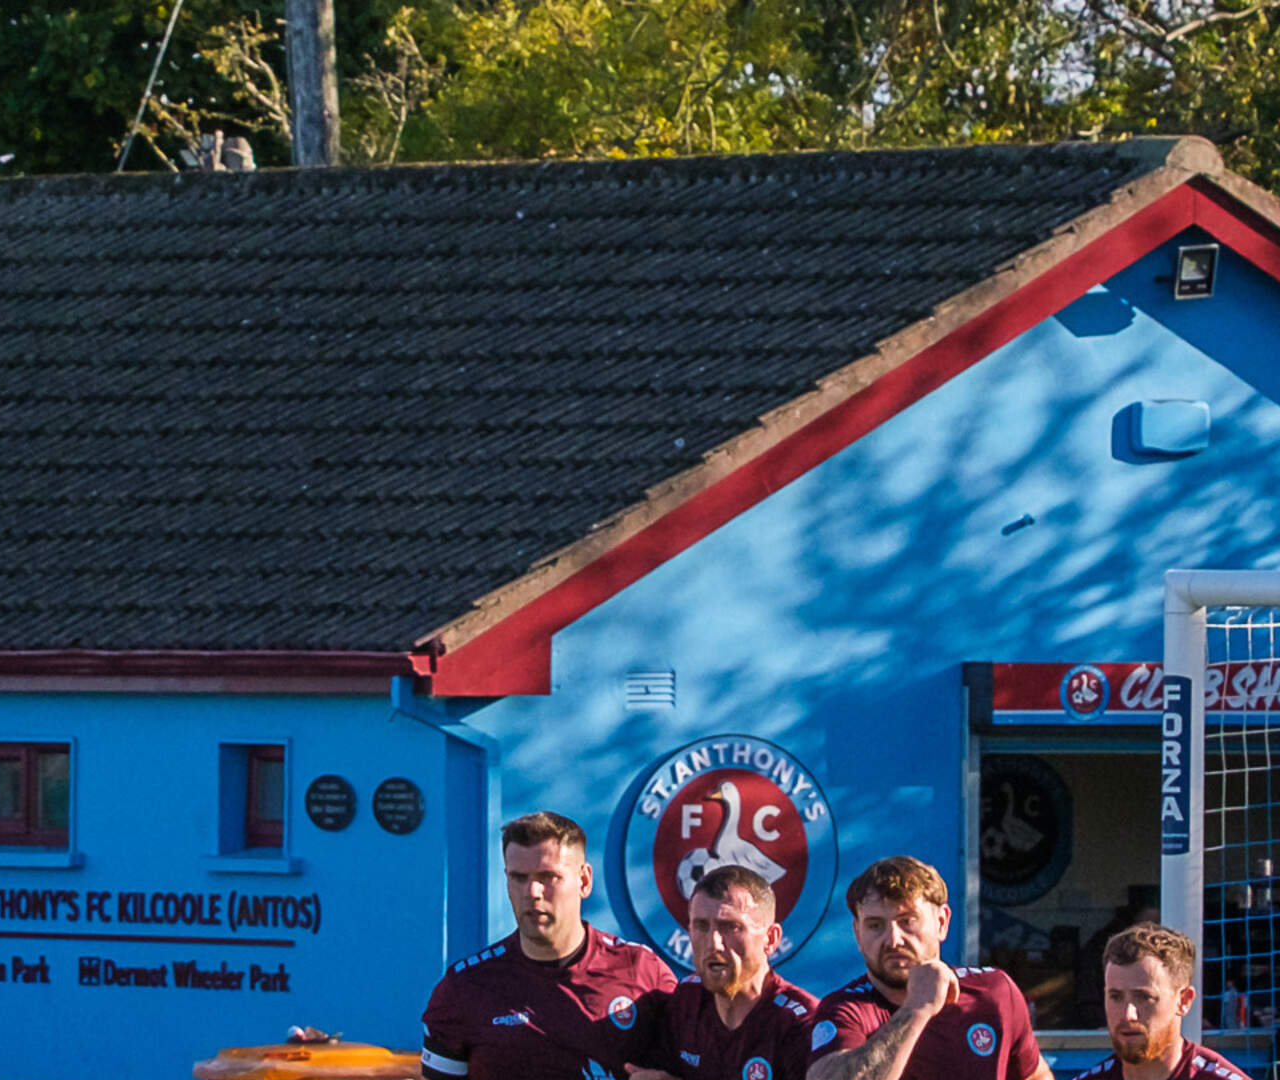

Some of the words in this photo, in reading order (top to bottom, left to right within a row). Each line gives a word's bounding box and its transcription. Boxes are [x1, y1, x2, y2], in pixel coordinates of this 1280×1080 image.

[1121, 665, 1226, 709] CLB
[1161, 684, 1184, 821] FORZA
[681, 804, 703, 839] F
[753, 805, 781, 842] C
[86, 891, 111, 923] FC
[117, 892, 222, 926] KILCOOLE
[228, 890, 321, 934] (ANTOS)
[12, 955, 51, 984] Park
[104, 958, 168, 988] Dermot
[172, 960, 245, 990] Wheeler
[250, 963, 291, 993] Park
